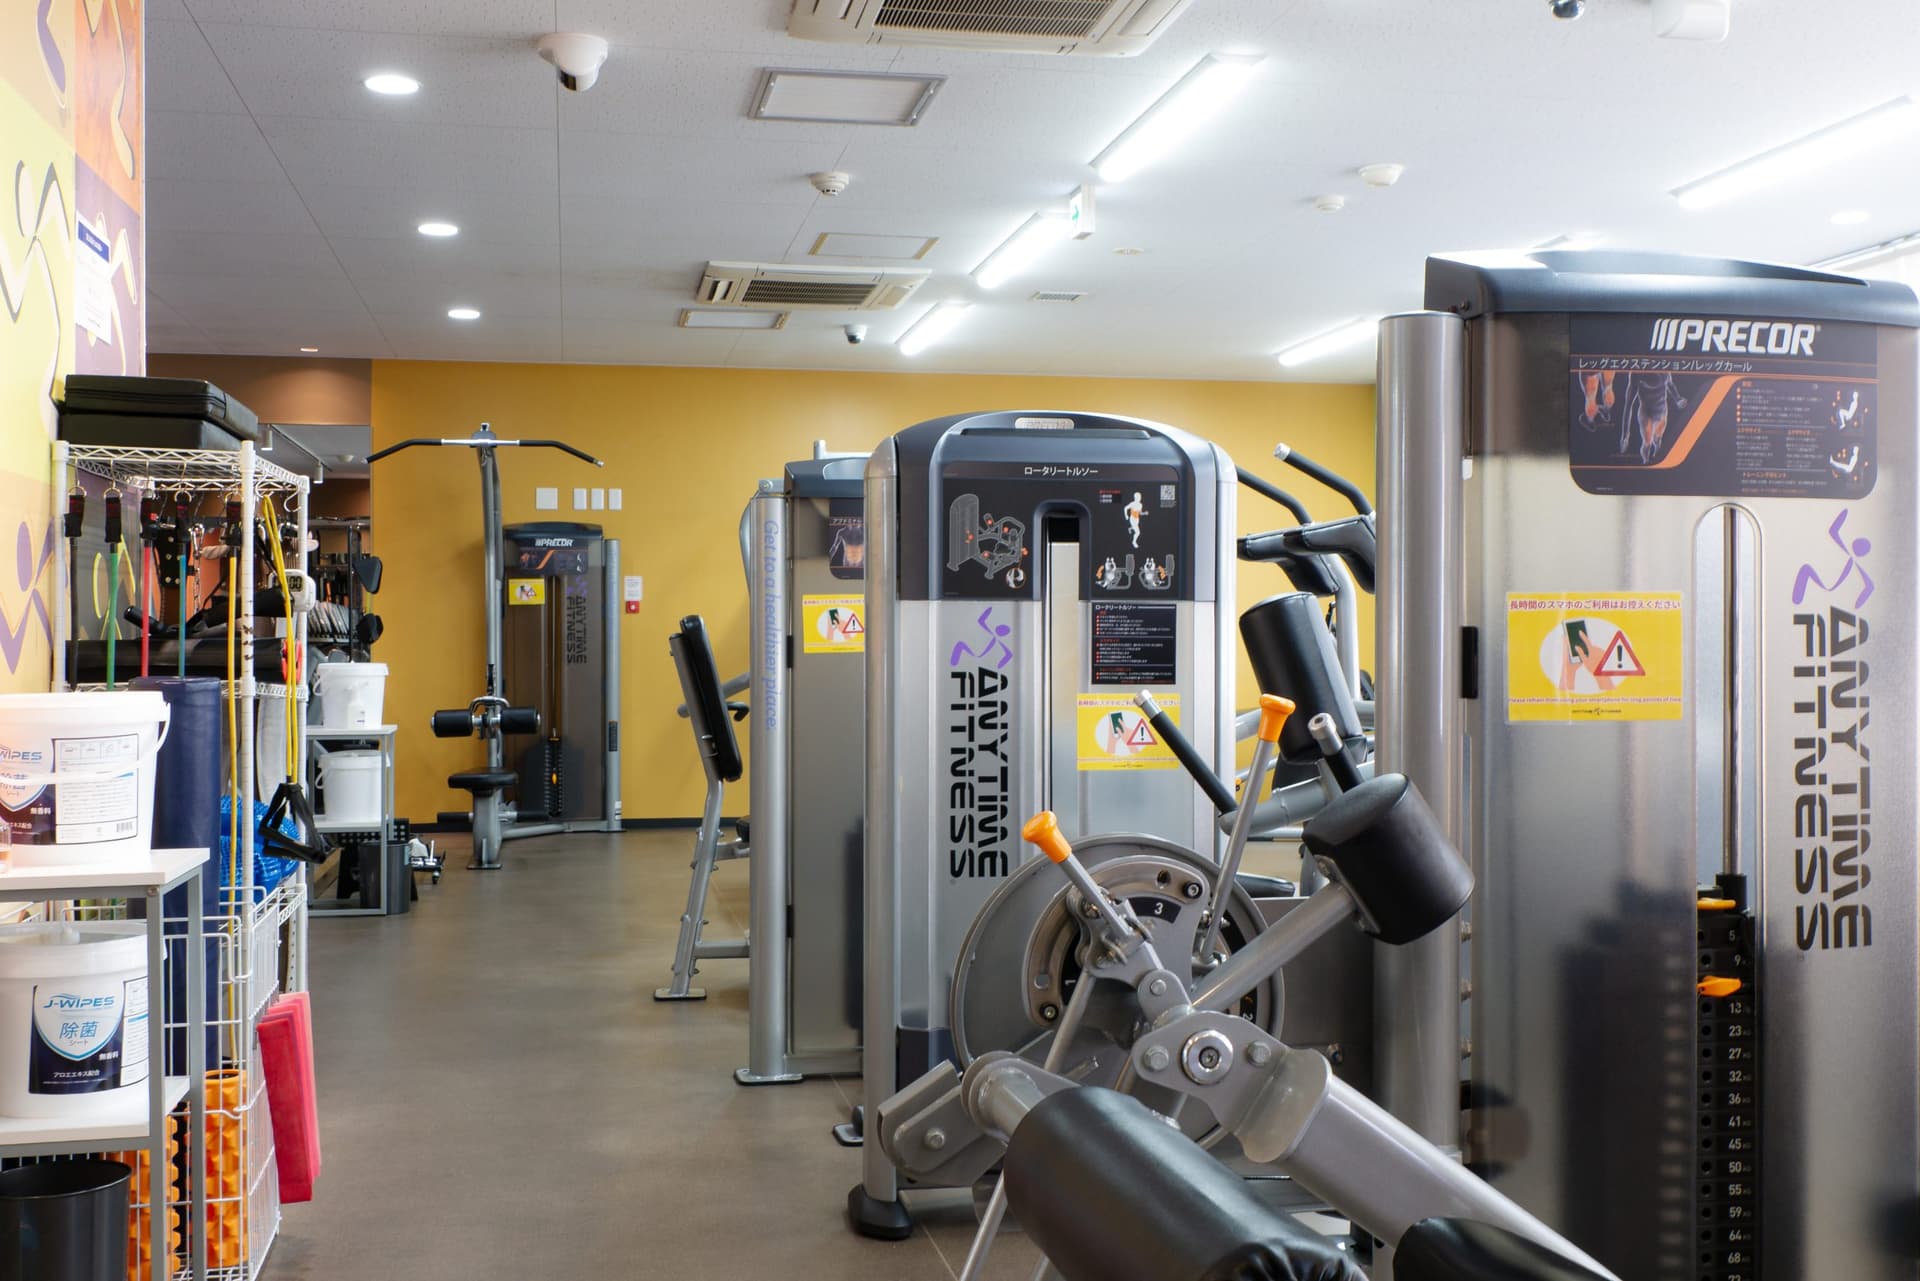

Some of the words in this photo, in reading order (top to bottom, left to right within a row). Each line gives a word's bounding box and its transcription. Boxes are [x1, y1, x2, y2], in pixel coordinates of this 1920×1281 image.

[1676, 319, 1816, 356] PRECOR
[1024, 466, 1099, 477] ロータリートルソー
[764, 519, 780, 550] Get
[540, 538, 574, 547] PRECOR
[764, 553, 776, 576] to
[764, 579, 776, 590] a
[1510, 600, 1681, 610] 長時間のスマホのご利用はお控えください
[566, 596, 576, 665] FITNESS
[575, 595, 588, 665] ANYTIME
[764, 594, 783, 674] healthier
[950, 671, 976, 879] FITNESS
[977, 666, 1009, 878] ANYTIME
[1829, 605, 1873, 948] ANYTIME
[1793, 613, 1829, 952] FITNESS
[1153, 902, 1164, 915] 3
[1729, 930, 1736, 941] 5
[1734, 955, 1741, 966] 9
[43, 996, 115, 1009] J-WIPES
[59, 1020, 99, 1040] 除菌
[1728, 1025, 1742, 1037] 23
[1728, 1047, 1742, 1060] 27
[1728, 1070, 1742, 1082] 32
[1728, 1093, 1742, 1105] 36
[1728, 1115, 1741, 1127] 41
[1728, 1138, 1742, 1150] 45
[1728, 1161, 1742, 1173] 50
[1728, 1183, 1742, 1196] 55
[1729, 1206, 1743, 1218] 59
[1729, 1229, 1742, 1241] 64
[1728, 1252, 1741, 1264] 68
